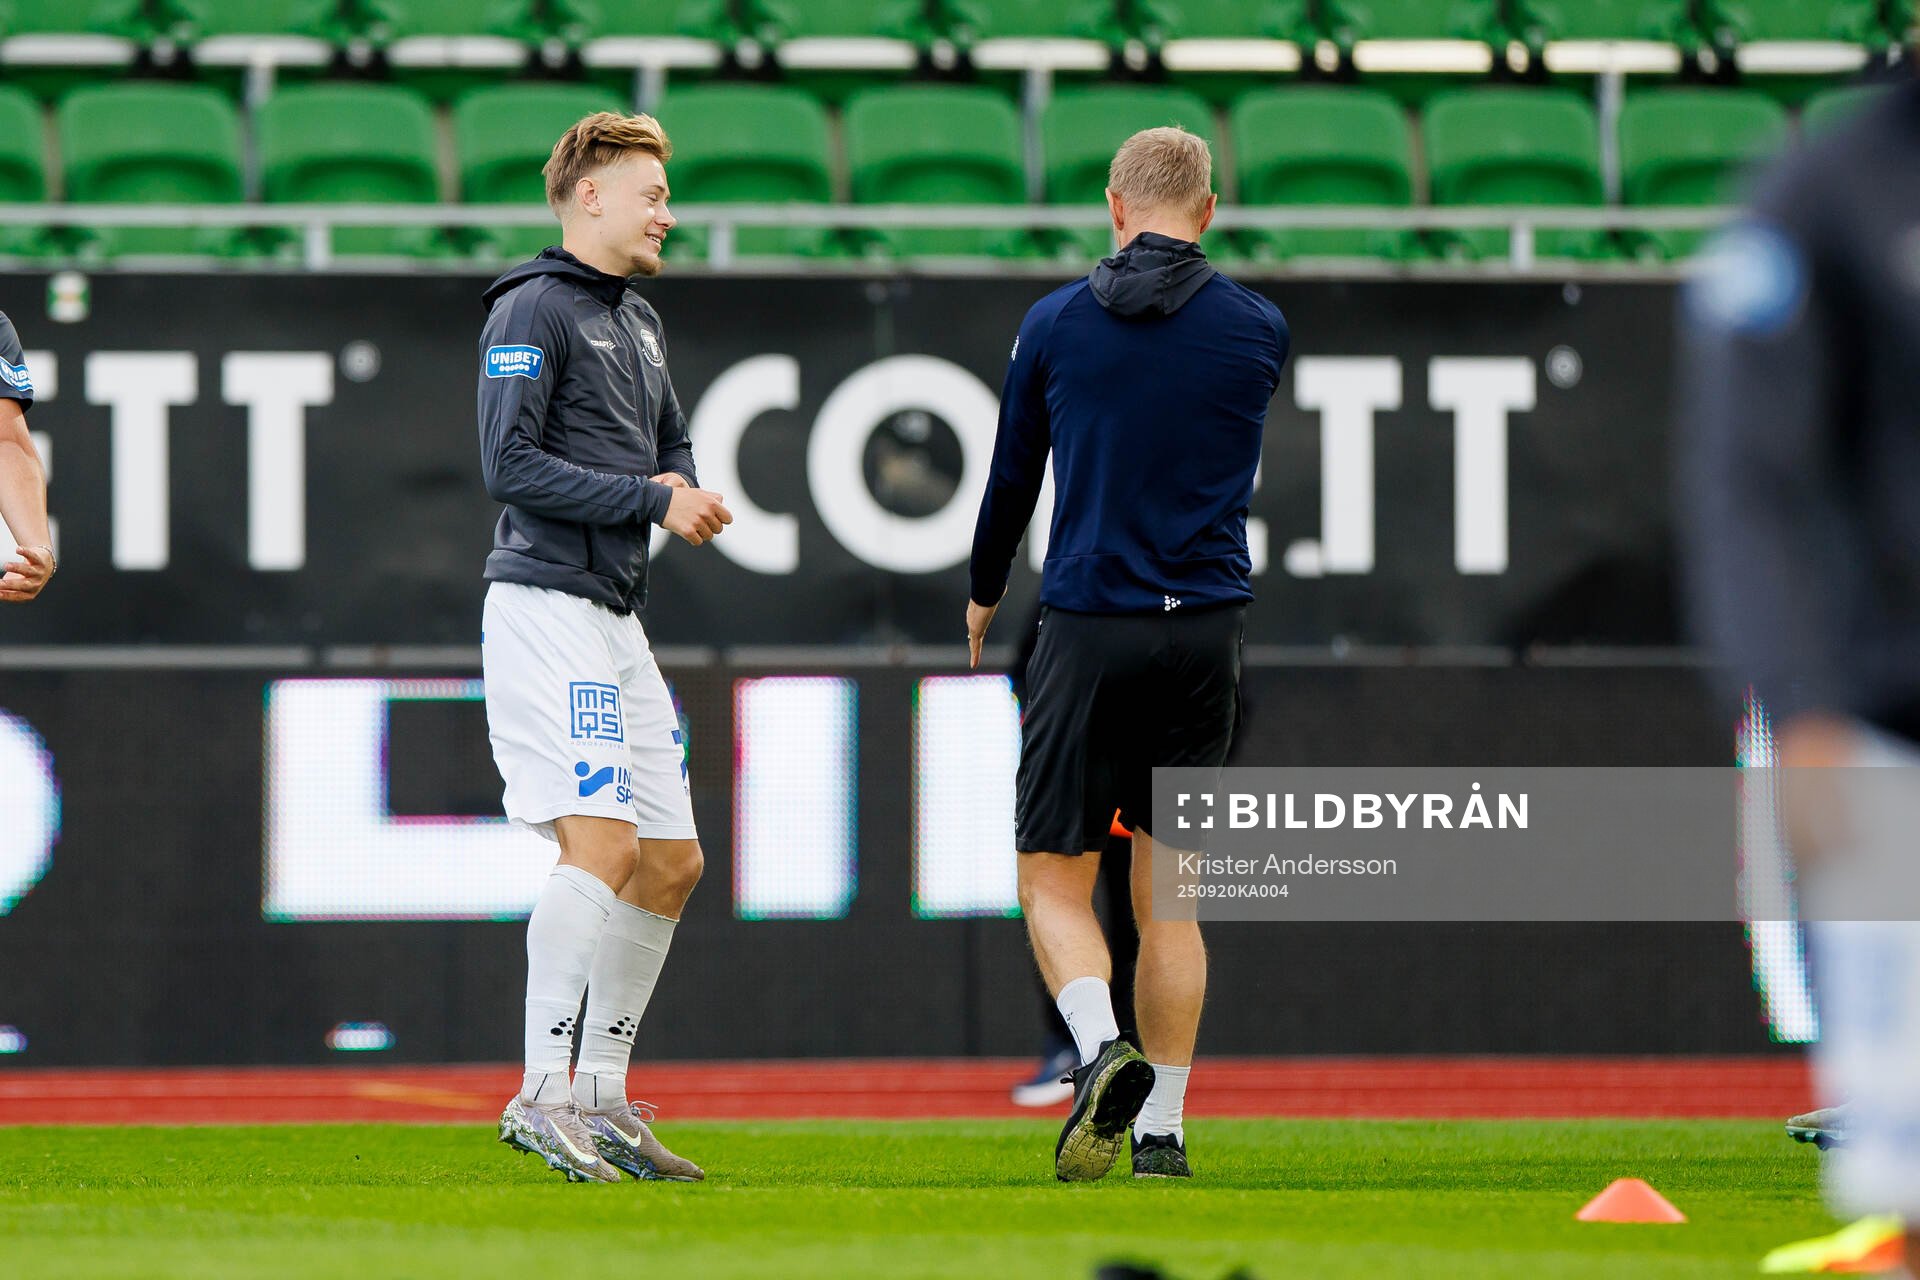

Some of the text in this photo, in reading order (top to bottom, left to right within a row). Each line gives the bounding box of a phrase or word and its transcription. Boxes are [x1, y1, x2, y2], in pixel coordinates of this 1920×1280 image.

[491, 351, 540, 366] UNIBET
[0, 361, 28, 381] UNIB
[618, 766, 632, 787] IN
